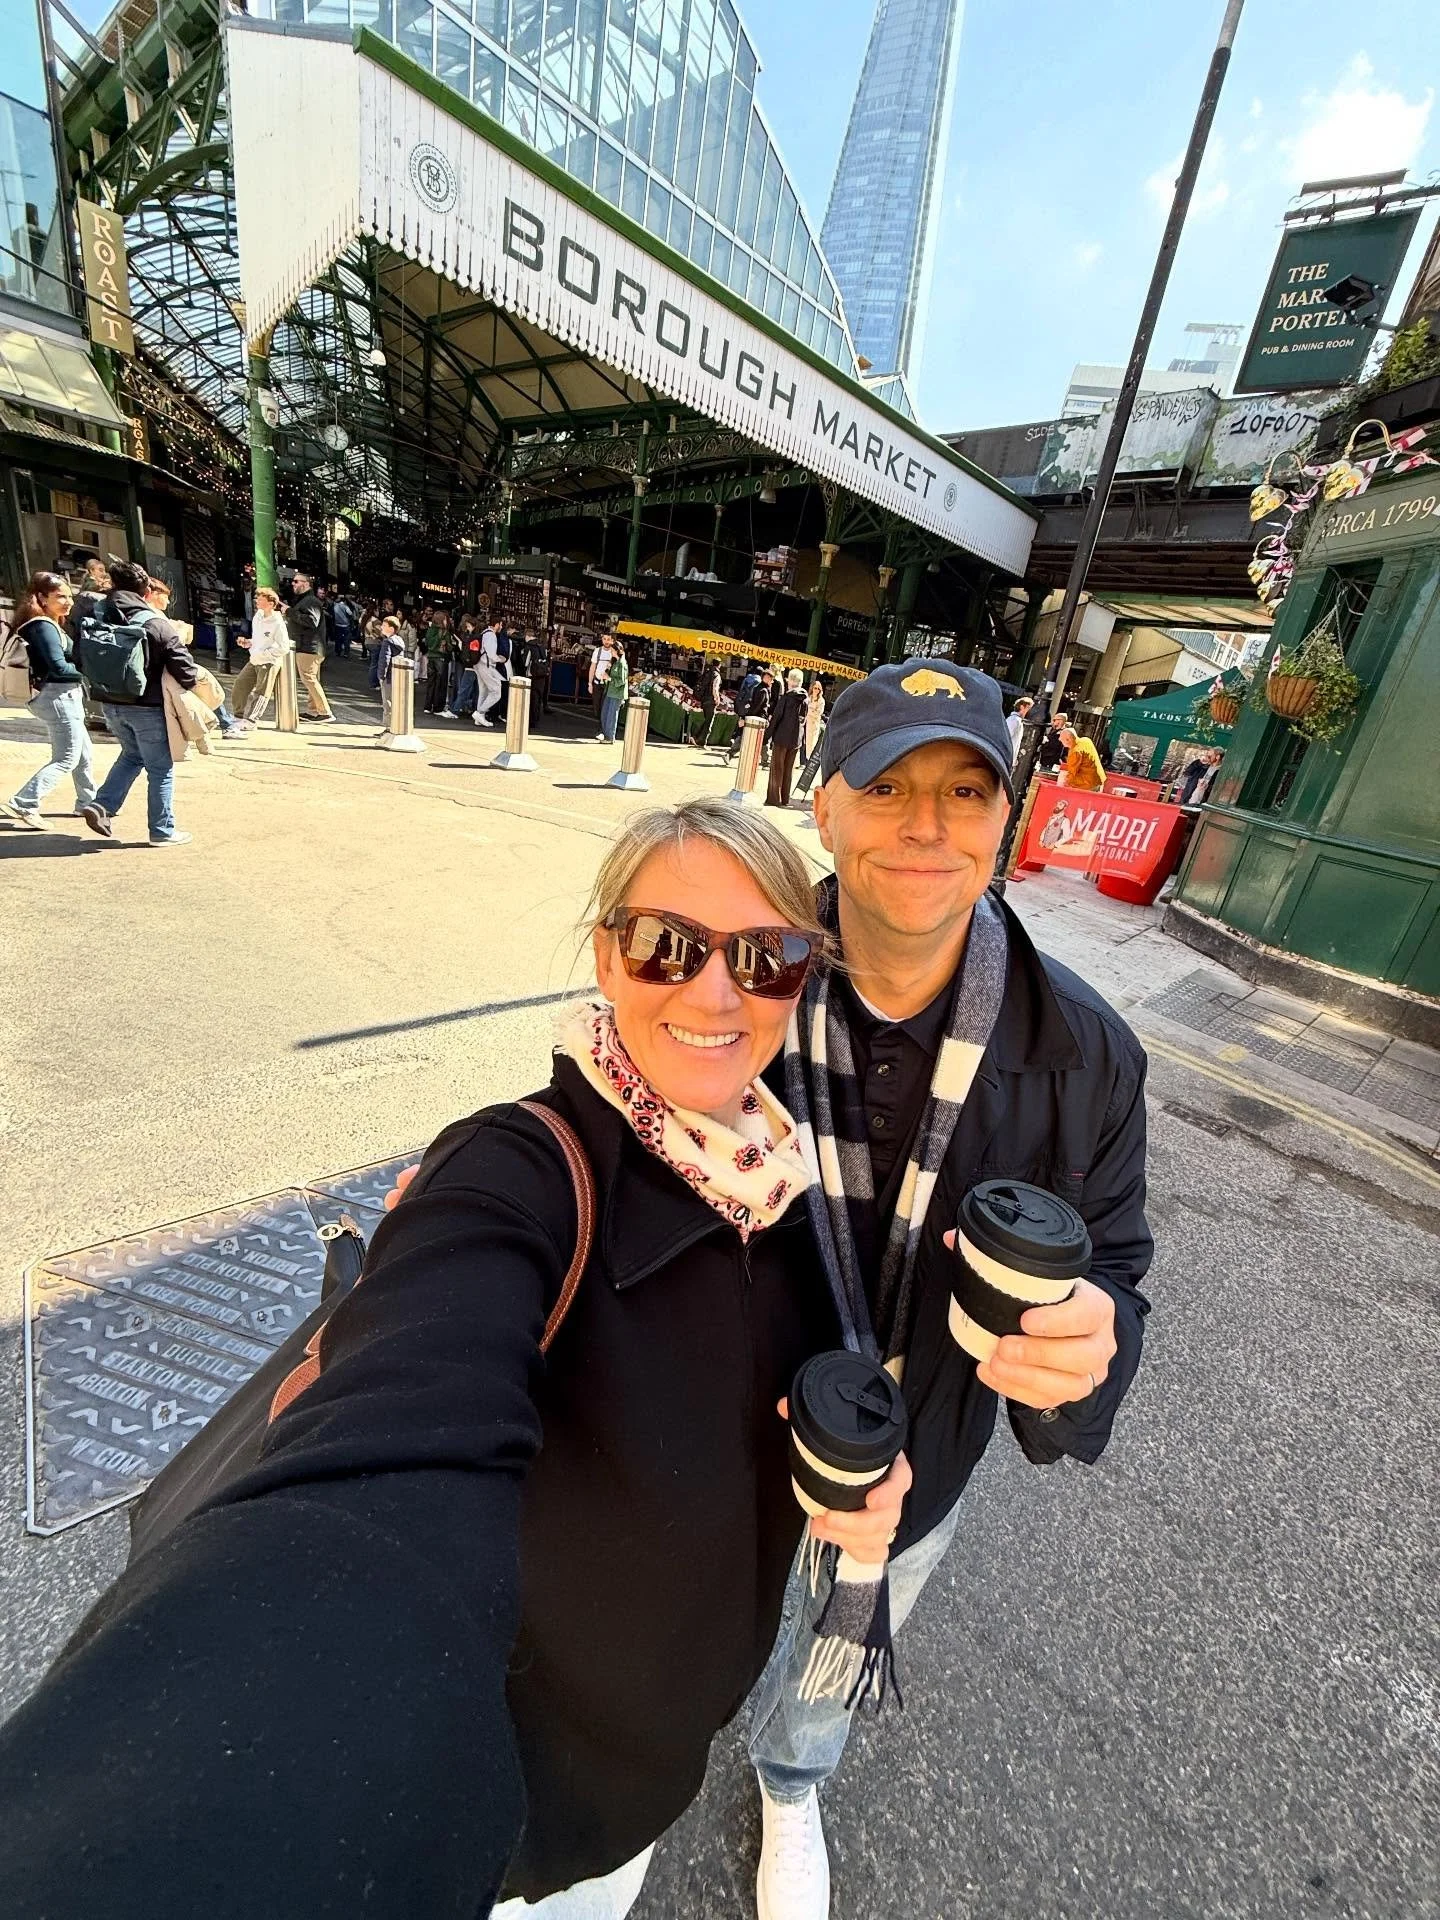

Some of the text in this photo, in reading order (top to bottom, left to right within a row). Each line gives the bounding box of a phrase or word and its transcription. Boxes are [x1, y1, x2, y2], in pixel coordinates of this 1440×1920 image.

[90, 211, 123, 342] ROAST
[1287, 262, 1330, 284] THE
[1276, 288, 1328, 309] MAR
[503, 197, 937, 498] BOROUGH MARKET
[1260, 338, 1355, 355] PUB & DINING ROOM
[1229, 412, 1318, 437] 10FOOT
[132, 417, 145, 461] ROAS
[1321, 495, 1437, 538] CIRCA 1799
[421, 581, 452, 594] FURNESS
[701, 639, 754, 654] BOROUGH
[835, 666, 868, 681] MARKET
[1142, 711, 1181, 722] TACOS
[1070, 807, 1160, 853] MADRÍ
[161, 1343, 248, 1381] DUCTILE
